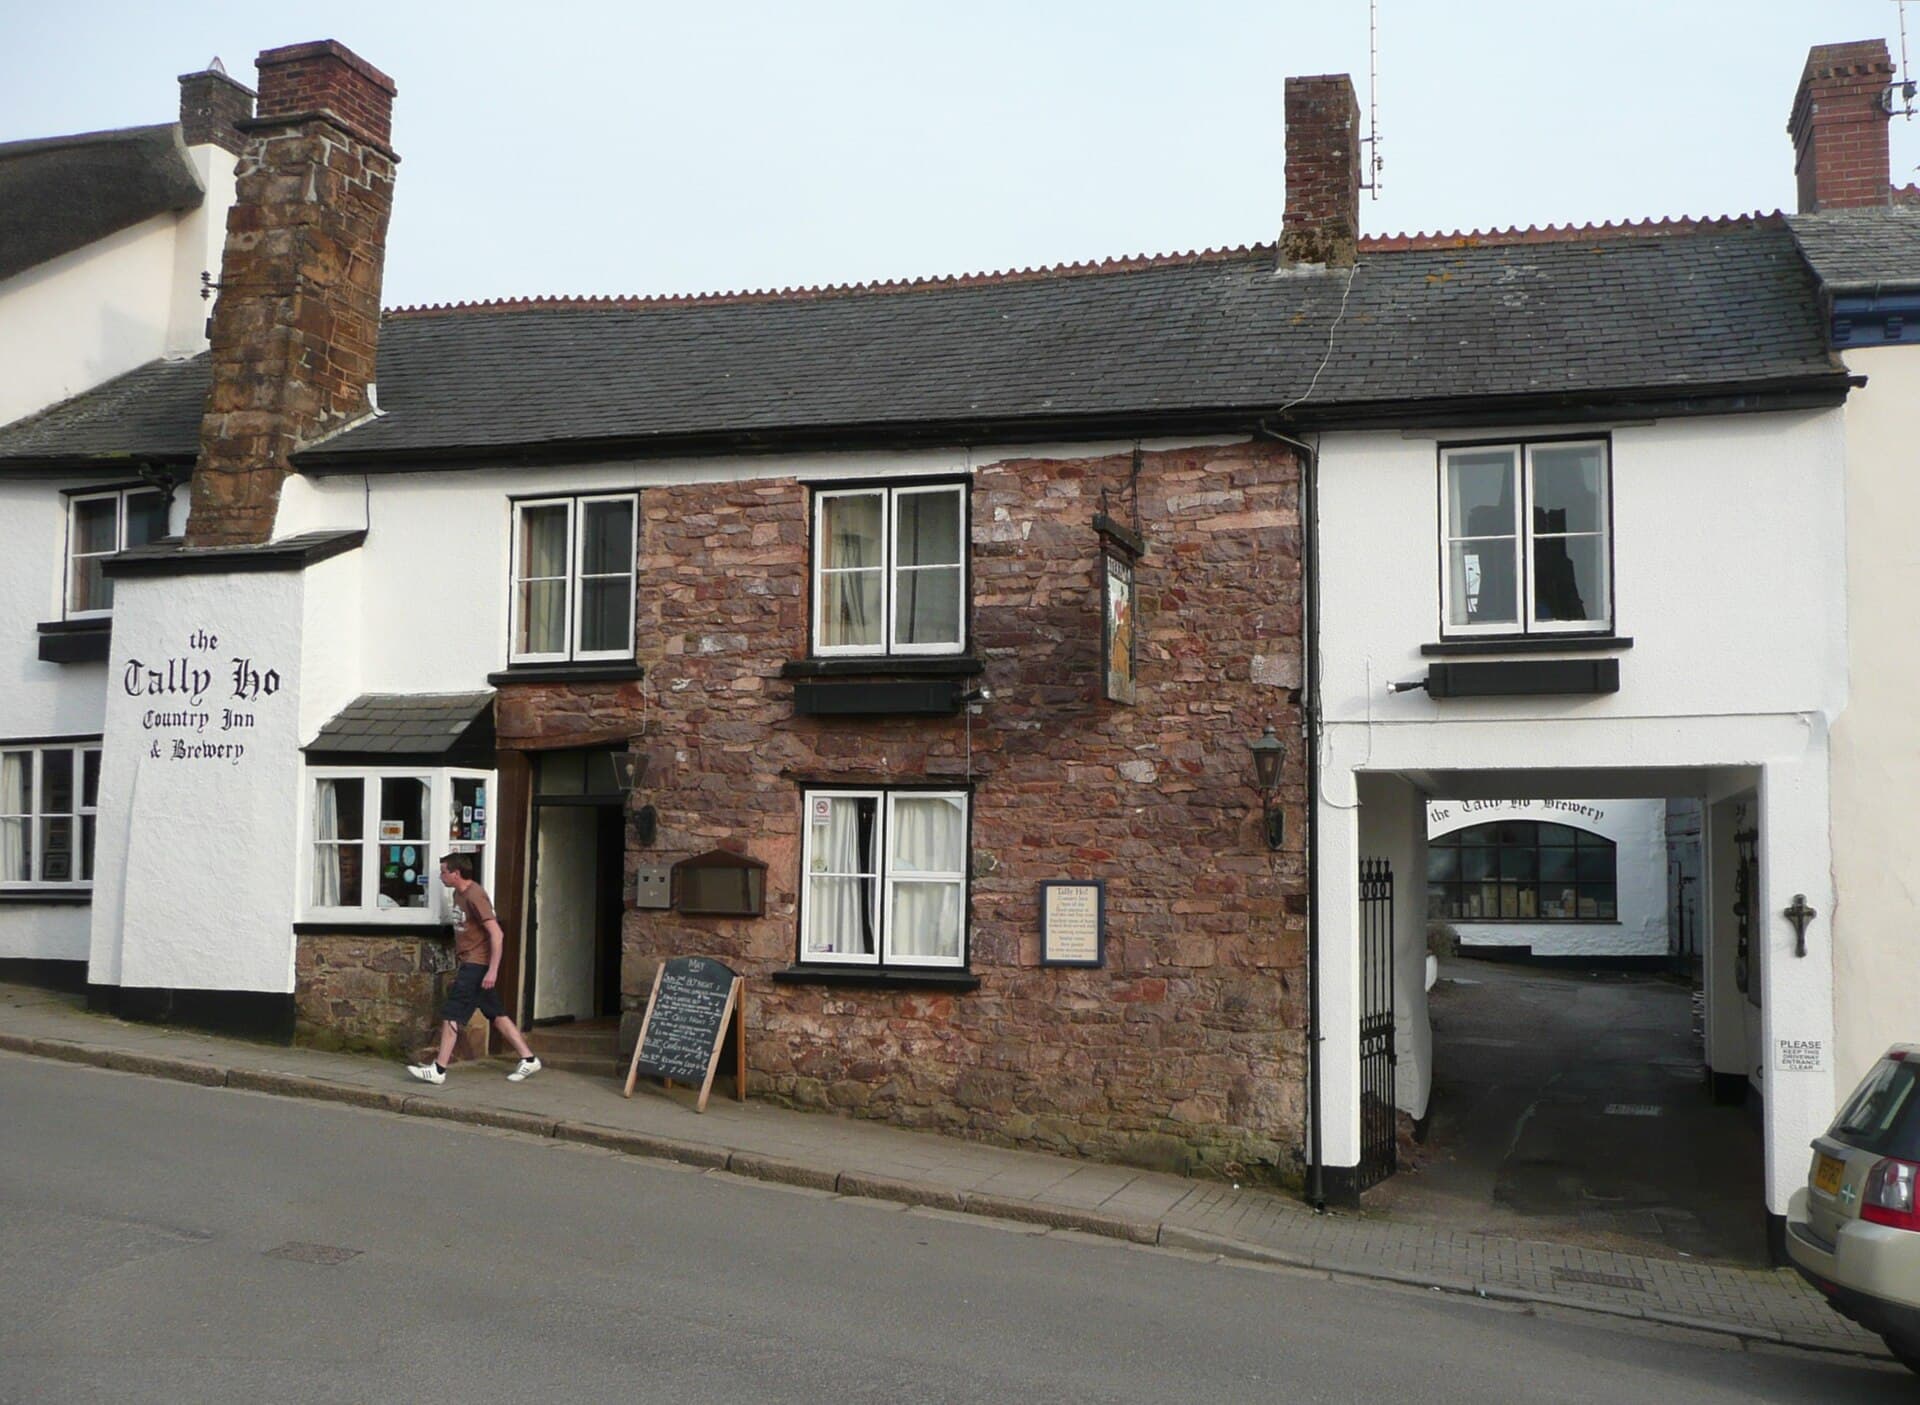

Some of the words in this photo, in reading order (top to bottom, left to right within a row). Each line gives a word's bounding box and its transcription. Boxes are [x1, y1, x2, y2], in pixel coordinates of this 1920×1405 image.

[190, 628, 219, 653] the
[124, 657, 212, 707] Tally
[230, 657, 281, 702] Ho
[142, 709, 209, 734] Country
[221, 708, 255, 731] Inn
[150, 738, 162, 759] &
[170, 738, 244, 766] Brewery
[1430, 808, 1451, 823] the
[1542, 799, 1604, 824] Brewery
[1780, 1040, 1822, 1049] PLEASE
